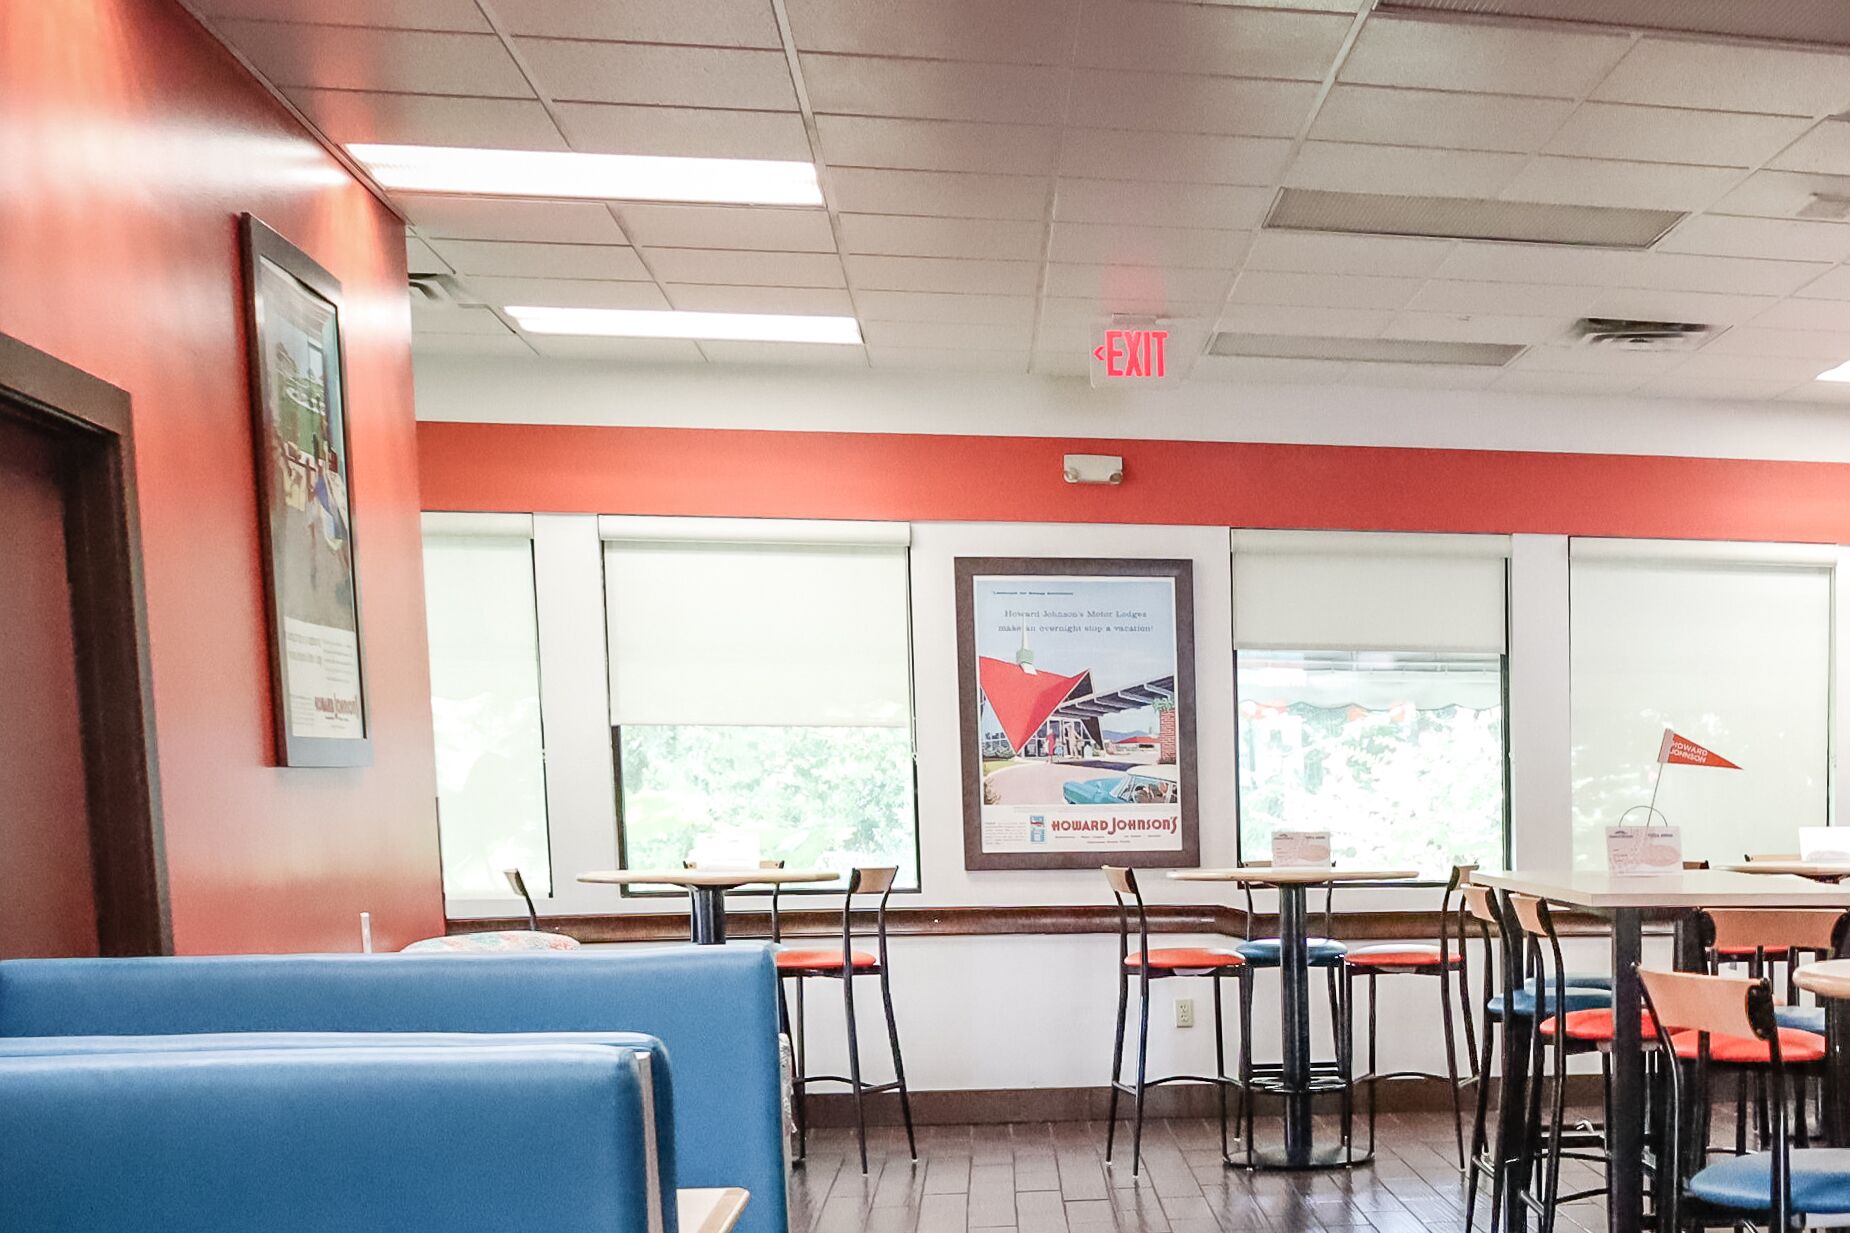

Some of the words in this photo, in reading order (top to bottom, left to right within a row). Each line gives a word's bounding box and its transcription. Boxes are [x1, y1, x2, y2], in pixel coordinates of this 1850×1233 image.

[1104, 329, 1169, 377] EXIT
[1670, 749, 1707, 763] JOHNSON
[1671, 741, 1708, 756] HOWARD
[1051, 820, 1108, 831] HOWARD
[1107, 817, 1178, 835] JOHNSON'S
